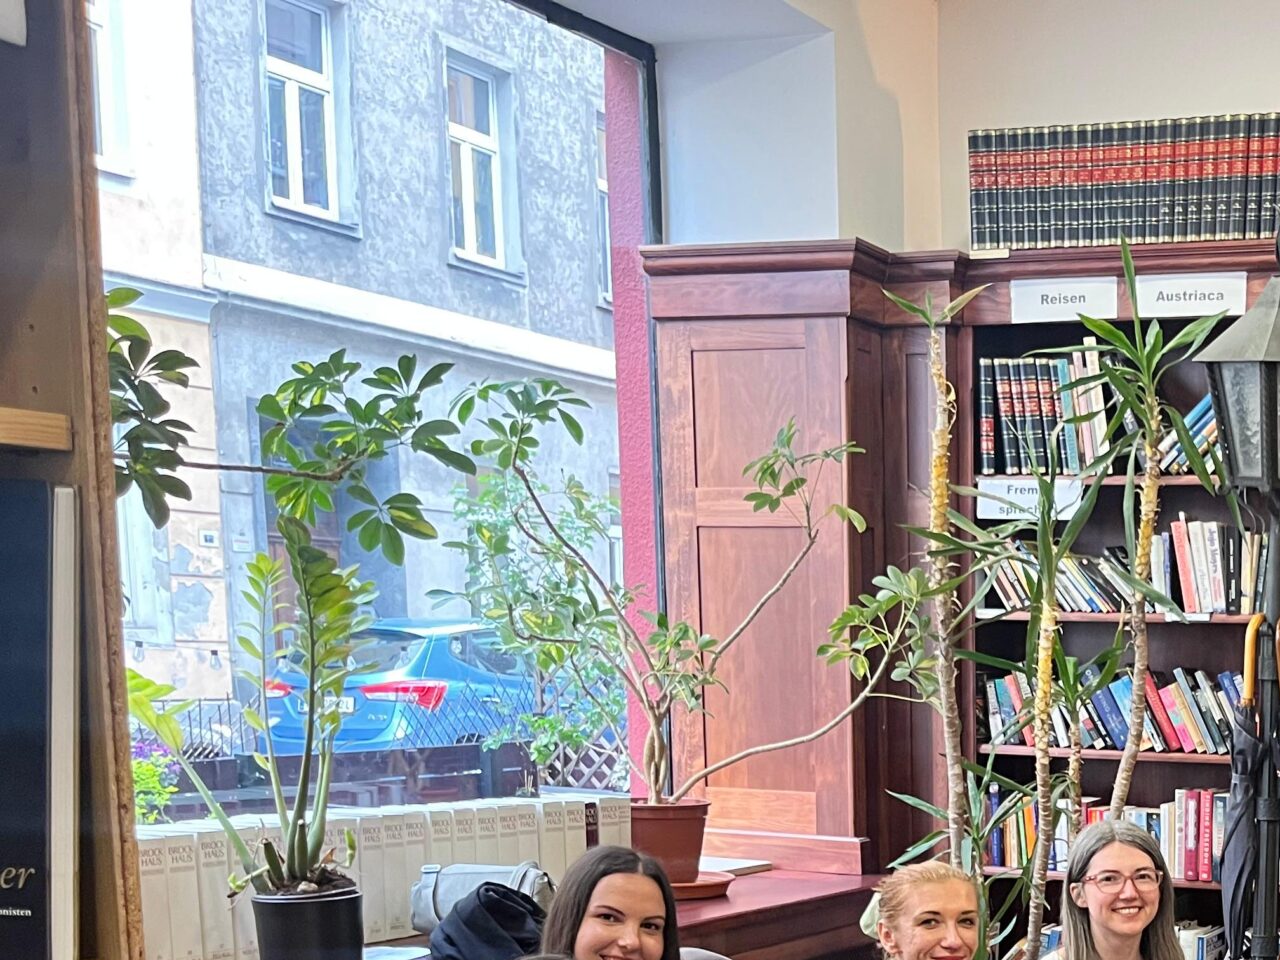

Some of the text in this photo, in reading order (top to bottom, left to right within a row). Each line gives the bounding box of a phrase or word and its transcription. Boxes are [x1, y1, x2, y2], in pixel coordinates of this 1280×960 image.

[1040, 294, 1086, 305] Reisen
[1156, 290, 1225, 303] Austriaca
[0, 906, 32, 917] nisten
